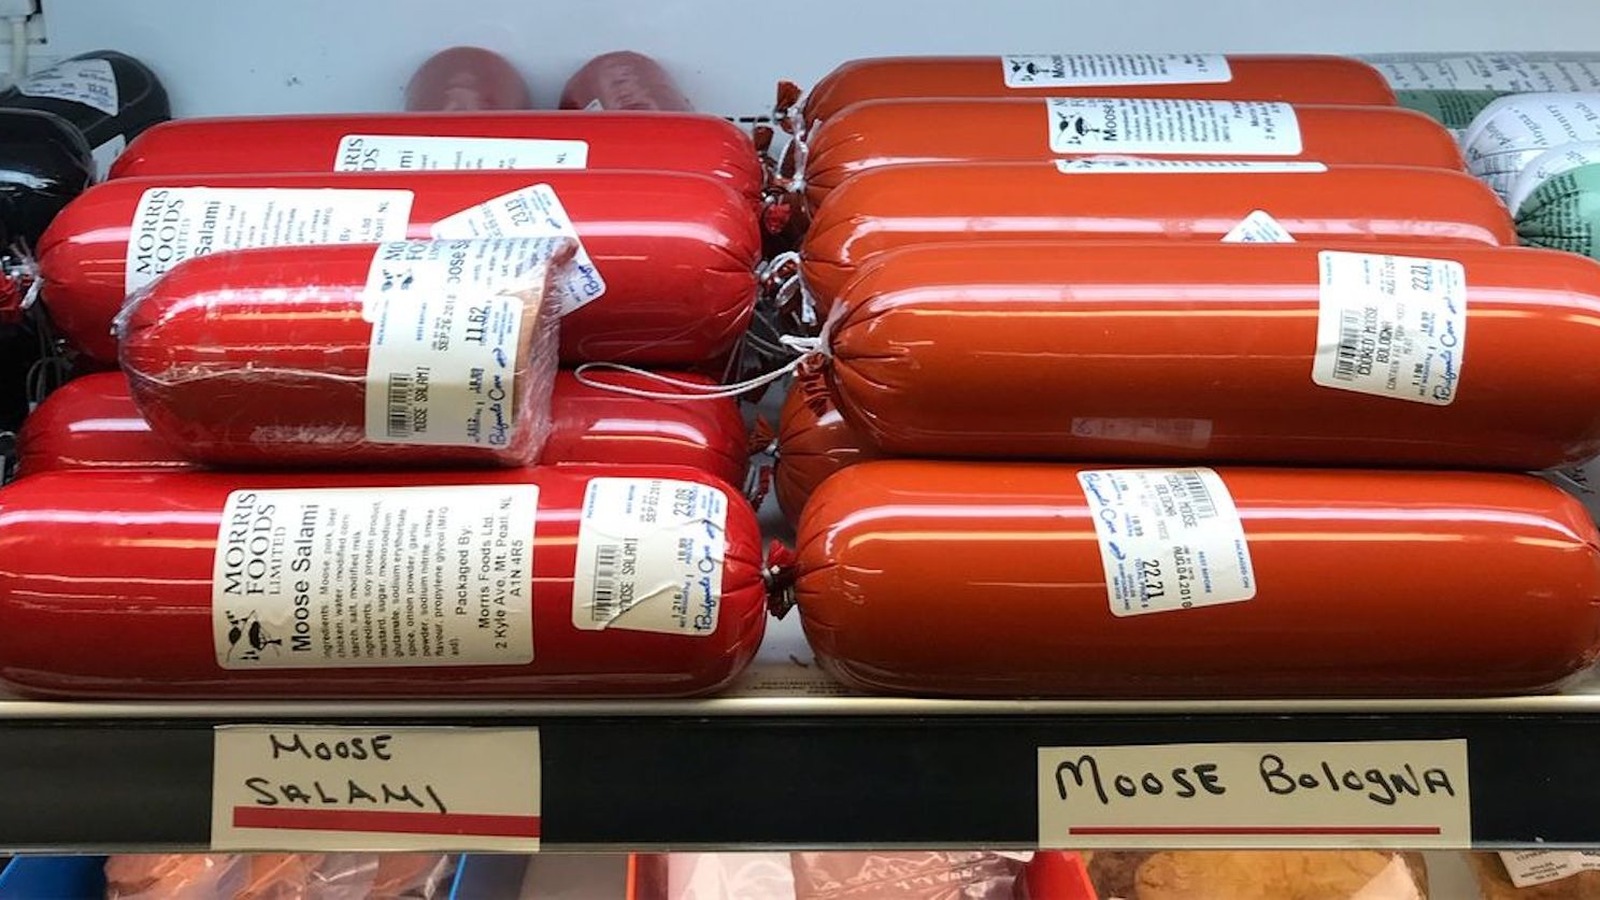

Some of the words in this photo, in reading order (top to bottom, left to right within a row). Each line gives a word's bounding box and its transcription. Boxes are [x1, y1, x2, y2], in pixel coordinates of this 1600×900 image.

[1547, 103, 1579, 140] ountry
[342, 138, 365, 167] RIS
[136, 190, 169, 275] MORRIS
[154, 199, 185, 274] FOODS
[194, 201, 221, 256] Salami
[464, 306, 486, 342] 11.62
[416, 366, 430, 402] SALAMI
[224, 493, 258, 596] MORRIS
[246, 504, 276, 595] FOODS
[291, 504, 319, 573] Salami
[510, 539, 524, 566] 4R5
[621, 538, 640, 576] SALAMI
[269, 526, 286, 595] LIMITED
[478, 539, 492, 582] Foods
[1142, 559, 1166, 600] 22.71
[418, 575, 429, 615] sodium
[454, 549, 471, 616] Packaged
[510, 569, 522, 598] A1N
[291, 580, 312, 652] Moose
[405, 596, 414, 628] onion
[478, 585, 492, 629] Morris
[493, 609, 509, 639] Kyle
[494, 640, 508, 650] 2
[269, 733, 394, 761] MOOSE
[245, 777, 448, 815] SALAMI
